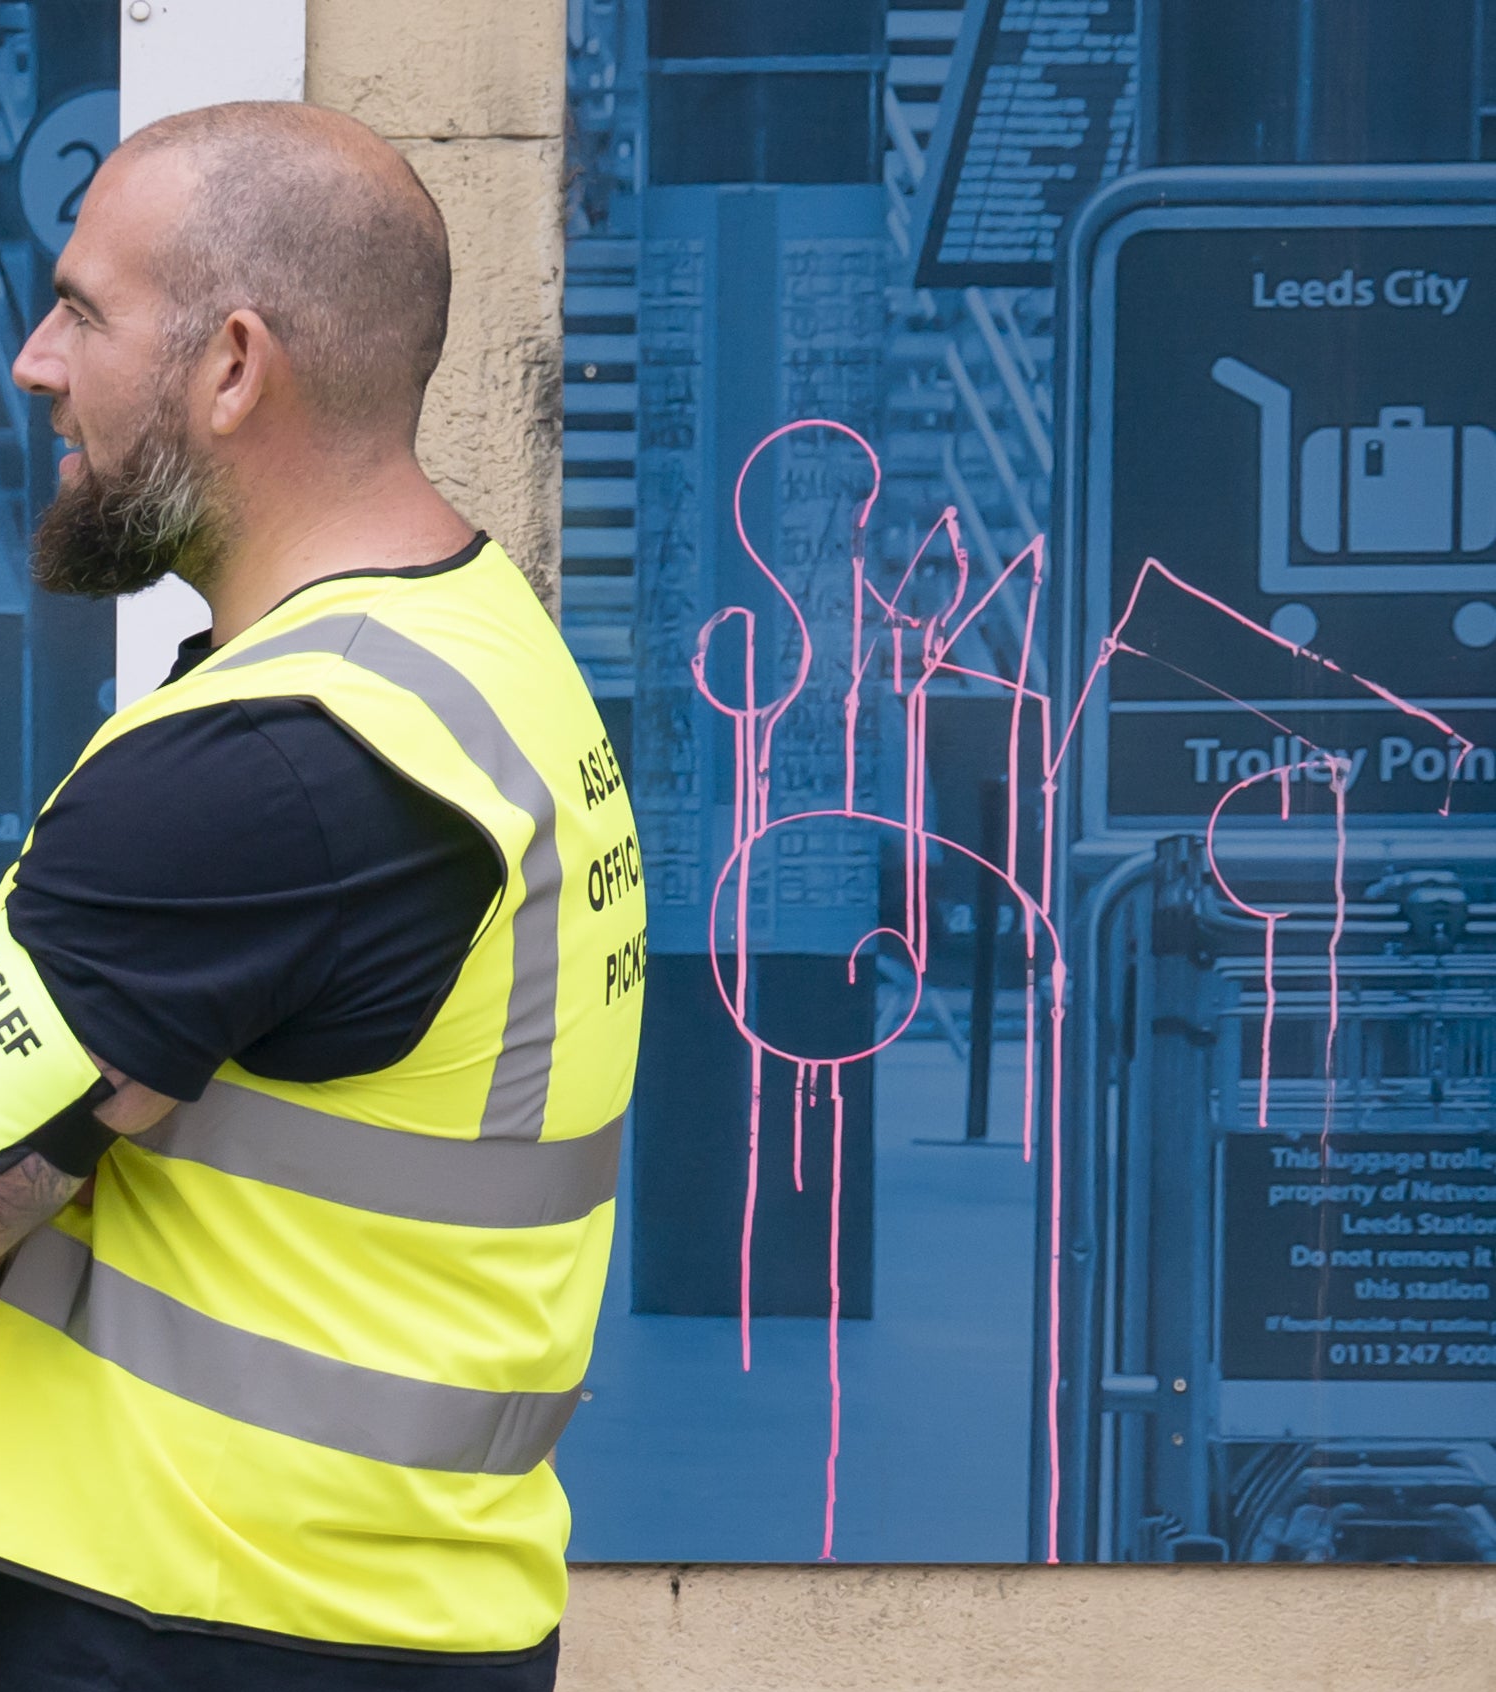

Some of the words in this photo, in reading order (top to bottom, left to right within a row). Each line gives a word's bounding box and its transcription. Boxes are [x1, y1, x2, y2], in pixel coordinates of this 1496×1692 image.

[57, 140, 102, 223] 2
[1252, 269, 1376, 307] Leeds
[1383, 269, 1469, 315] City
[1183, 734, 1368, 794] Trolley
[1270, 1147, 1320, 1169] This
[1325, 1145, 1425, 1175] luggage
[1268, 1183, 1377, 1207] property
[1380, 1179, 1408, 1201] of
[1341, 1212, 1413, 1235] Leeds
[1290, 1245, 1327, 1268] Do
[1330, 1248, 1373, 1268] not
[1377, 1249, 1470, 1268] remove
[1473, 1245, 1492, 1268] it
[1354, 1277, 1400, 1300] this
[1405, 1278, 1490, 1300] station
[1329, 1343, 1391, 1365] 0113
[1395, 1343, 1442, 1365] 247
